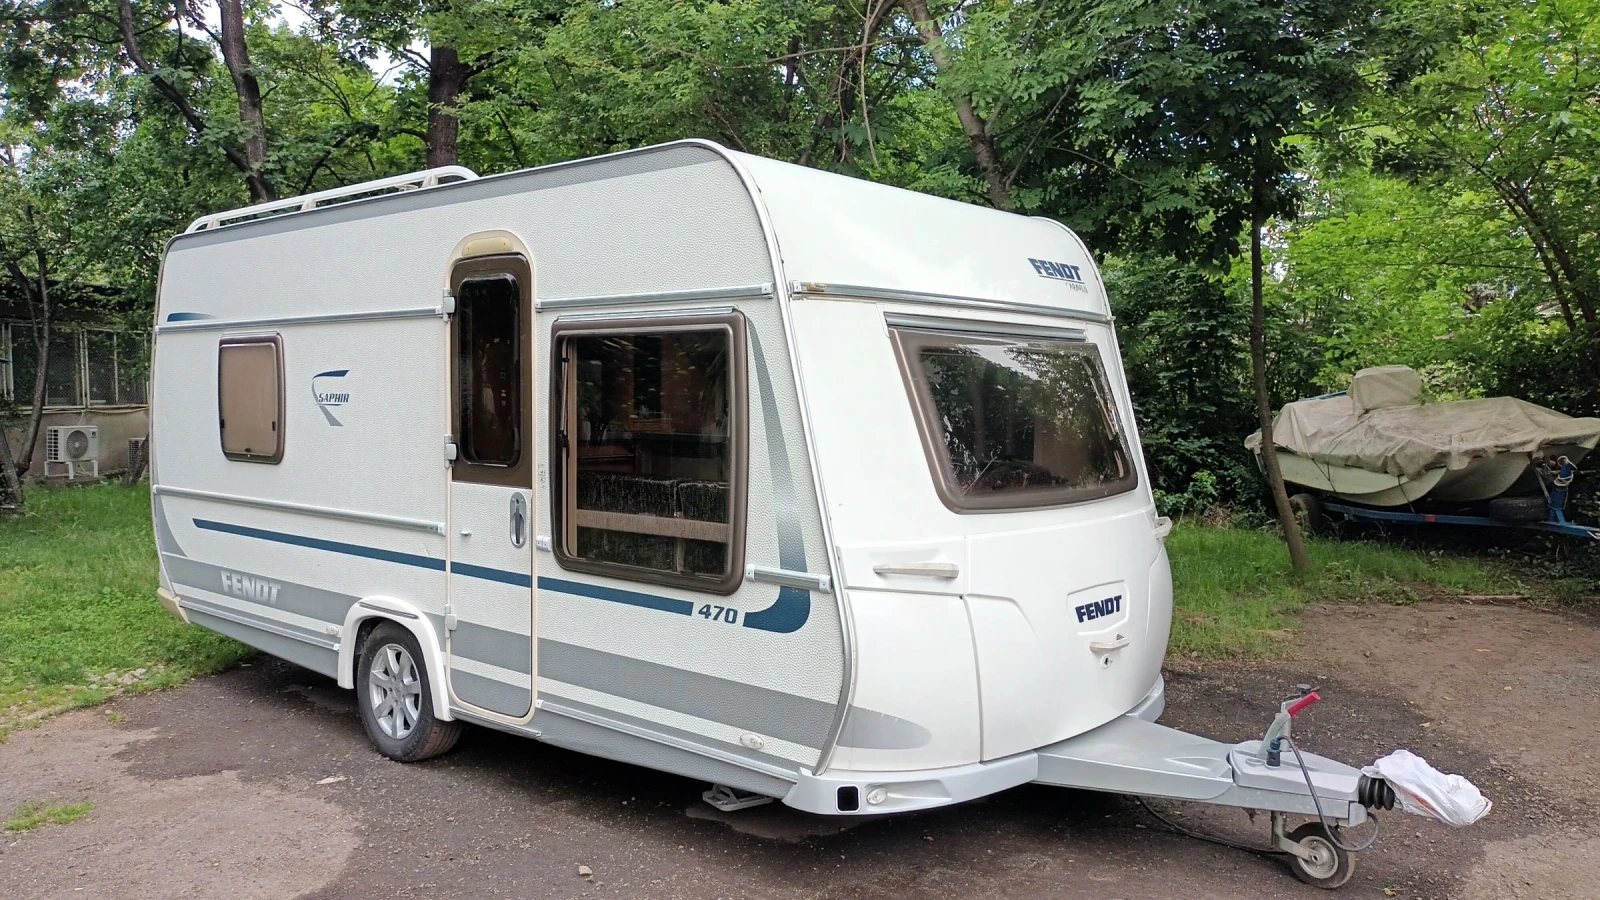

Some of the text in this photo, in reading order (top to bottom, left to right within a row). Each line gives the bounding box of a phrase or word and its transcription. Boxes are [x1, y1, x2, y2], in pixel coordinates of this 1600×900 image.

[1027, 258, 1082, 281] FENDT
[318, 393, 350, 403] SAPHIR
[220, 569, 282, 605] FENDT
[698, 603, 738, 624] 470
[1074, 594, 1122, 623] FENDT
